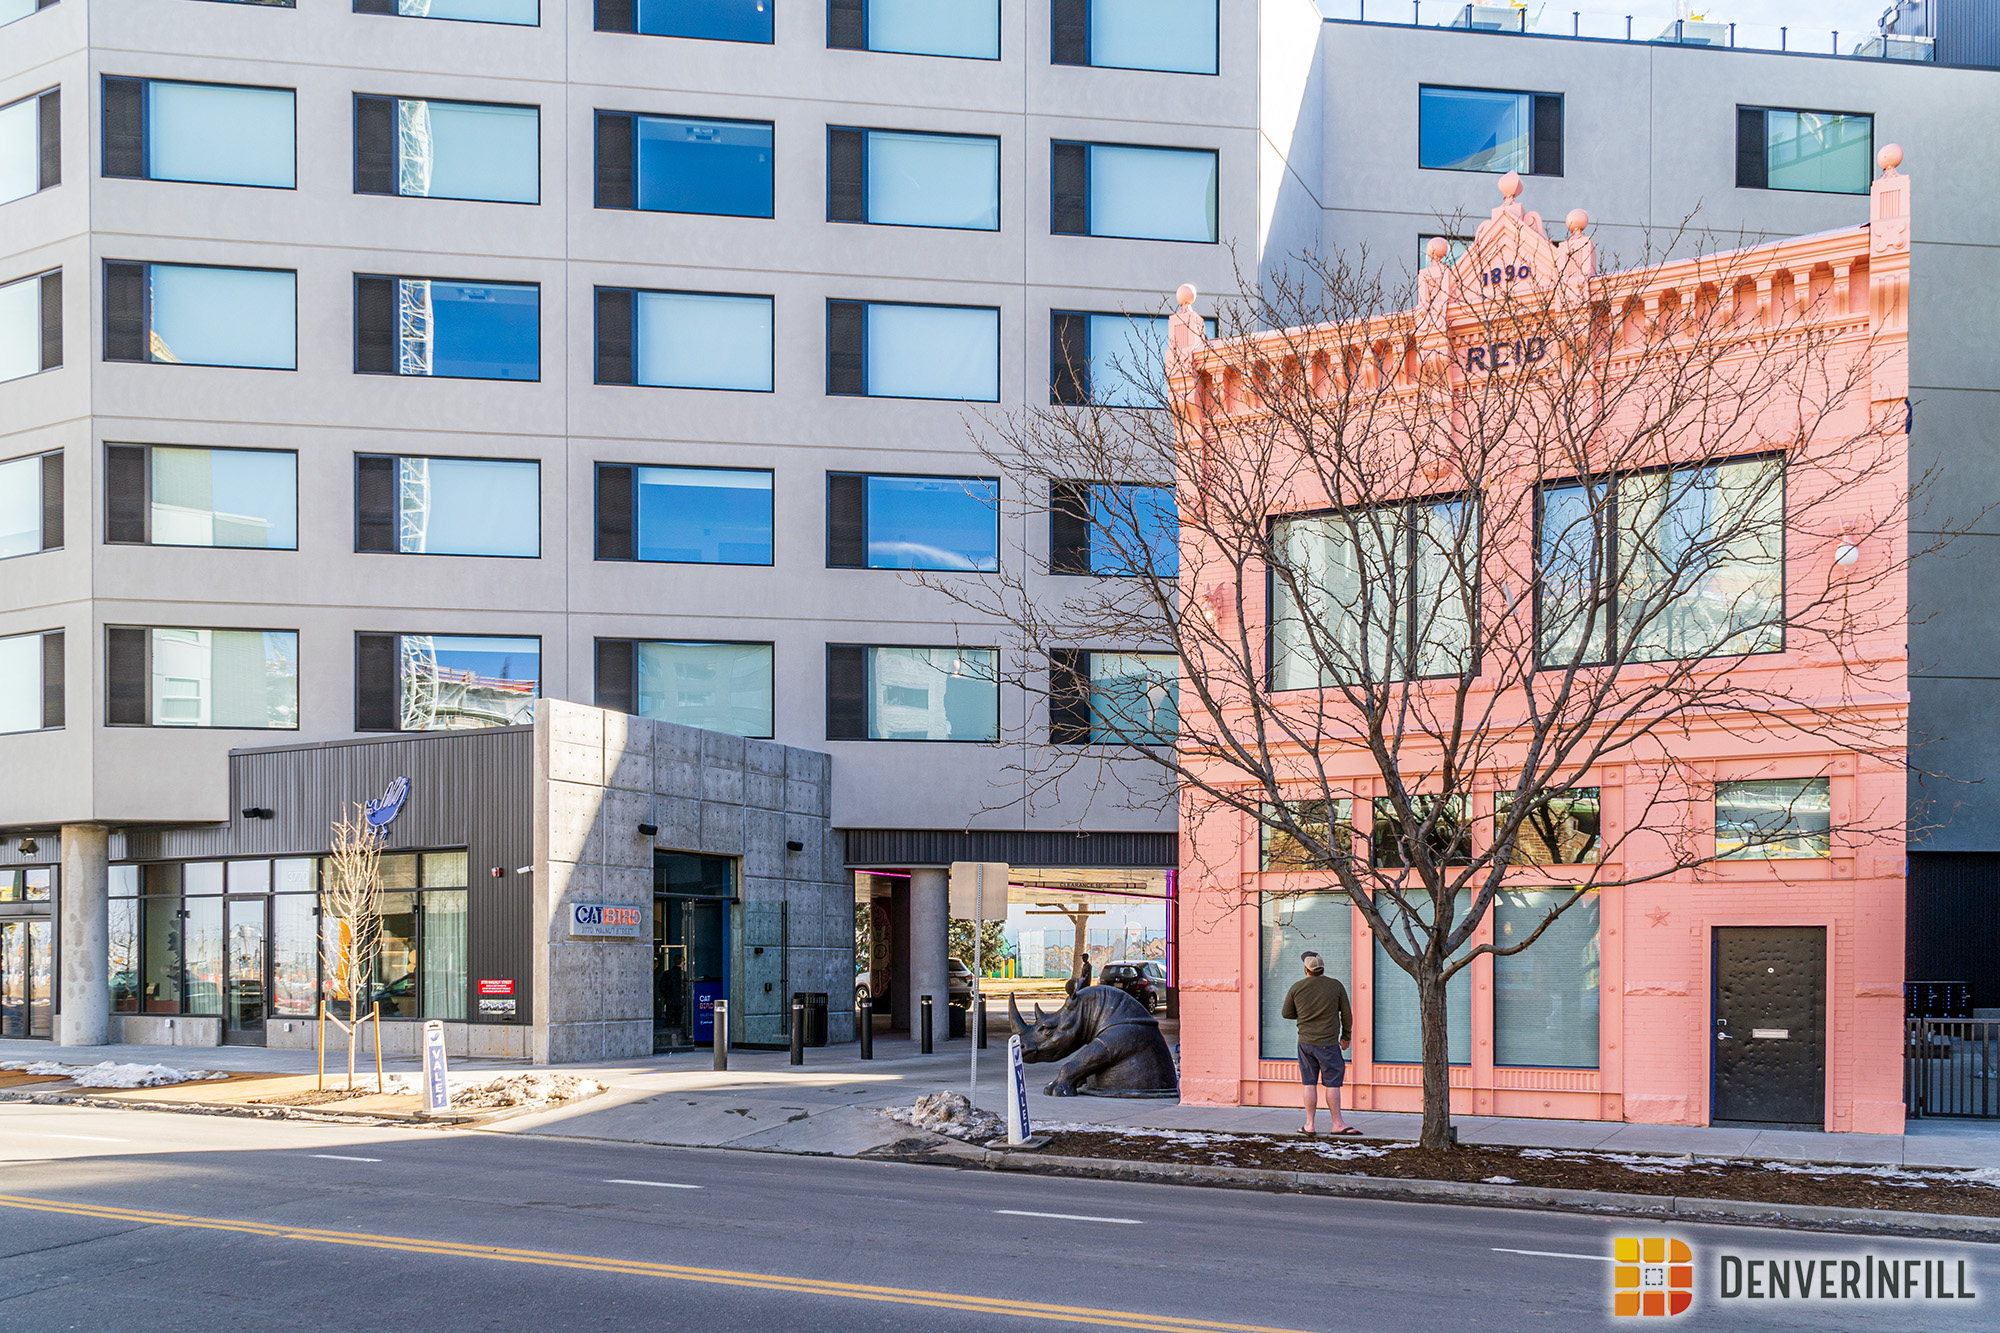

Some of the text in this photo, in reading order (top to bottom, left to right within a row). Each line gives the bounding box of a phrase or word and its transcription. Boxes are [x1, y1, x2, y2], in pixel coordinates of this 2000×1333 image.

[1483, 265, 1530, 287] 1890
[1467, 337, 1546, 372] REID
[287, 871, 308, 882] 3770
[1060, 881, 1094, 889] CLEARANCE
[594, 926, 615, 935] WALNUT
[616, 927, 634, 935] STREET
[432, 1049, 443, 1104] VALET
[1017, 1070, 1028, 1134] VALET
